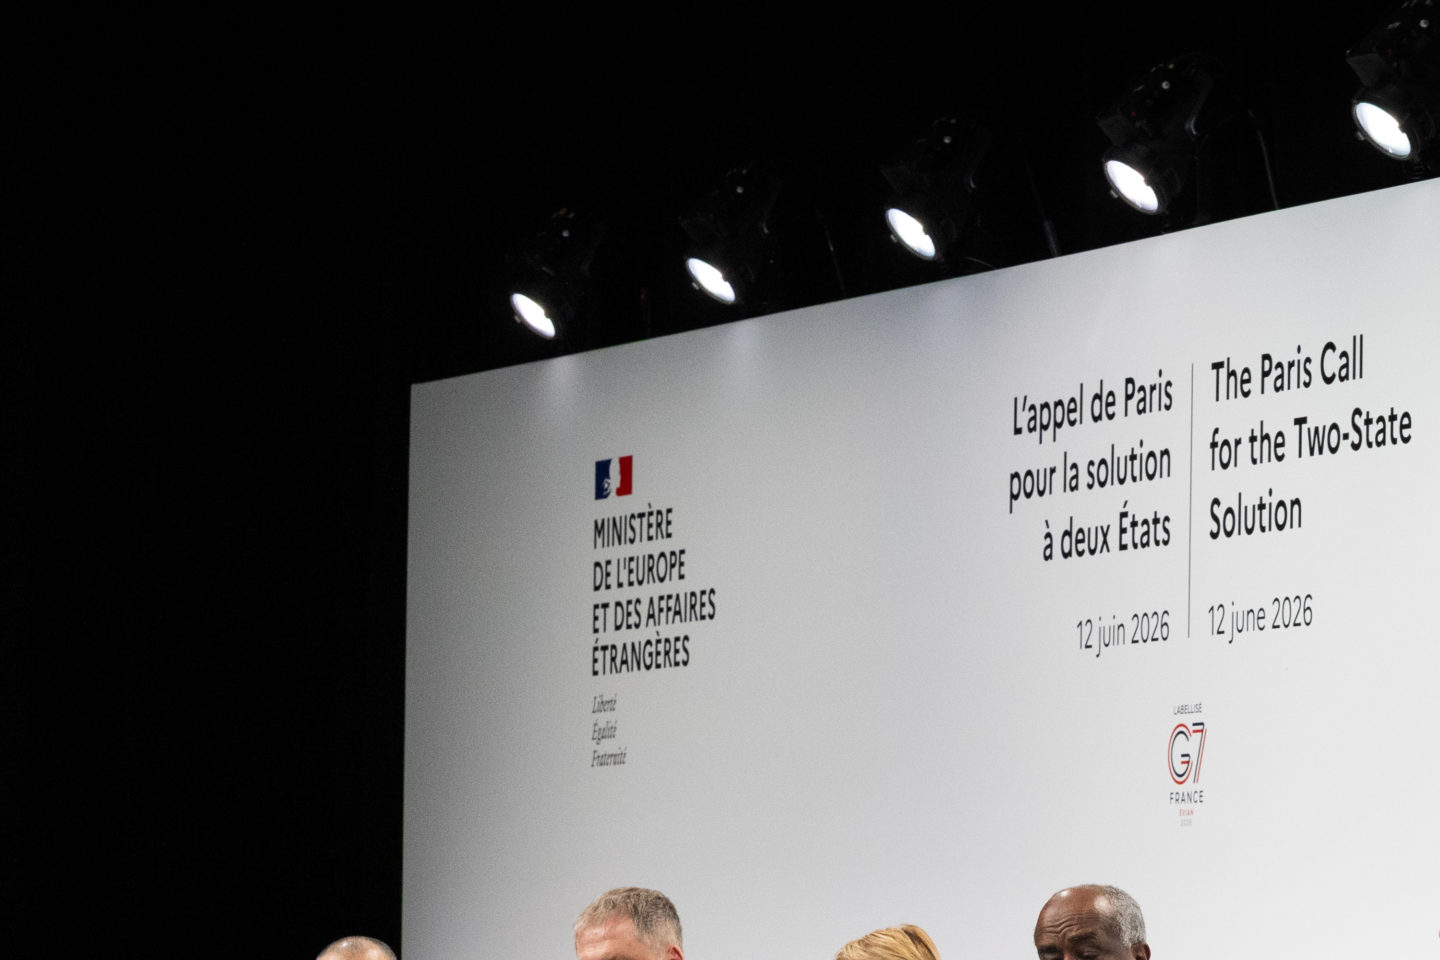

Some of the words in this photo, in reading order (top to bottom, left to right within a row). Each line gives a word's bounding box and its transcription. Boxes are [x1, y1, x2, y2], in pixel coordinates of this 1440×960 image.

[1210, 356, 1252, 403] The
[1260, 344, 1313, 395] Paris
[1319, 333, 1365, 386] Call
[1013, 382, 1084, 445] L’appel
[1090, 378, 1117, 424] de
[1124, 368, 1174, 418] Paris
[1208, 426, 1243, 472] for
[1248, 419, 1286, 466] the
[1293, 405, 1413, 459] Two-State
[1009, 464, 1057, 515] pour
[1062, 450, 1080, 494] la
[1086, 438, 1172, 491] solution
[593, 502, 674, 550] MINISTÈRE
[1042, 519, 1054, 562] à
[1060, 515, 1111, 560] deux
[1118, 499, 1172, 552] États
[1208, 487, 1303, 541] Solution
[593, 559, 612, 592] DE
[616, 548, 686, 589] L'EUROPE
[592, 602, 610, 635] ET
[614, 597, 642, 632] DES
[645, 586, 717, 628] AFFAIRES
[1076, 618, 1093, 650] 12
[1095, 614, 1127, 659] juin
[1130, 609, 1171, 645] 2026
[1208, 603, 1227, 637] 12
[1226, 600, 1267, 645] june
[1271, 593, 1314, 630] 2026
[591, 630, 691, 677] ÉTRANGÈRES
[591, 693, 618, 714] Liberté
[591, 720, 618, 745] Égalité
[1167, 721, 1208, 785] G7
[590, 748, 627, 768] Fraternité
[1169, 790, 1205, 805] FRANCE
